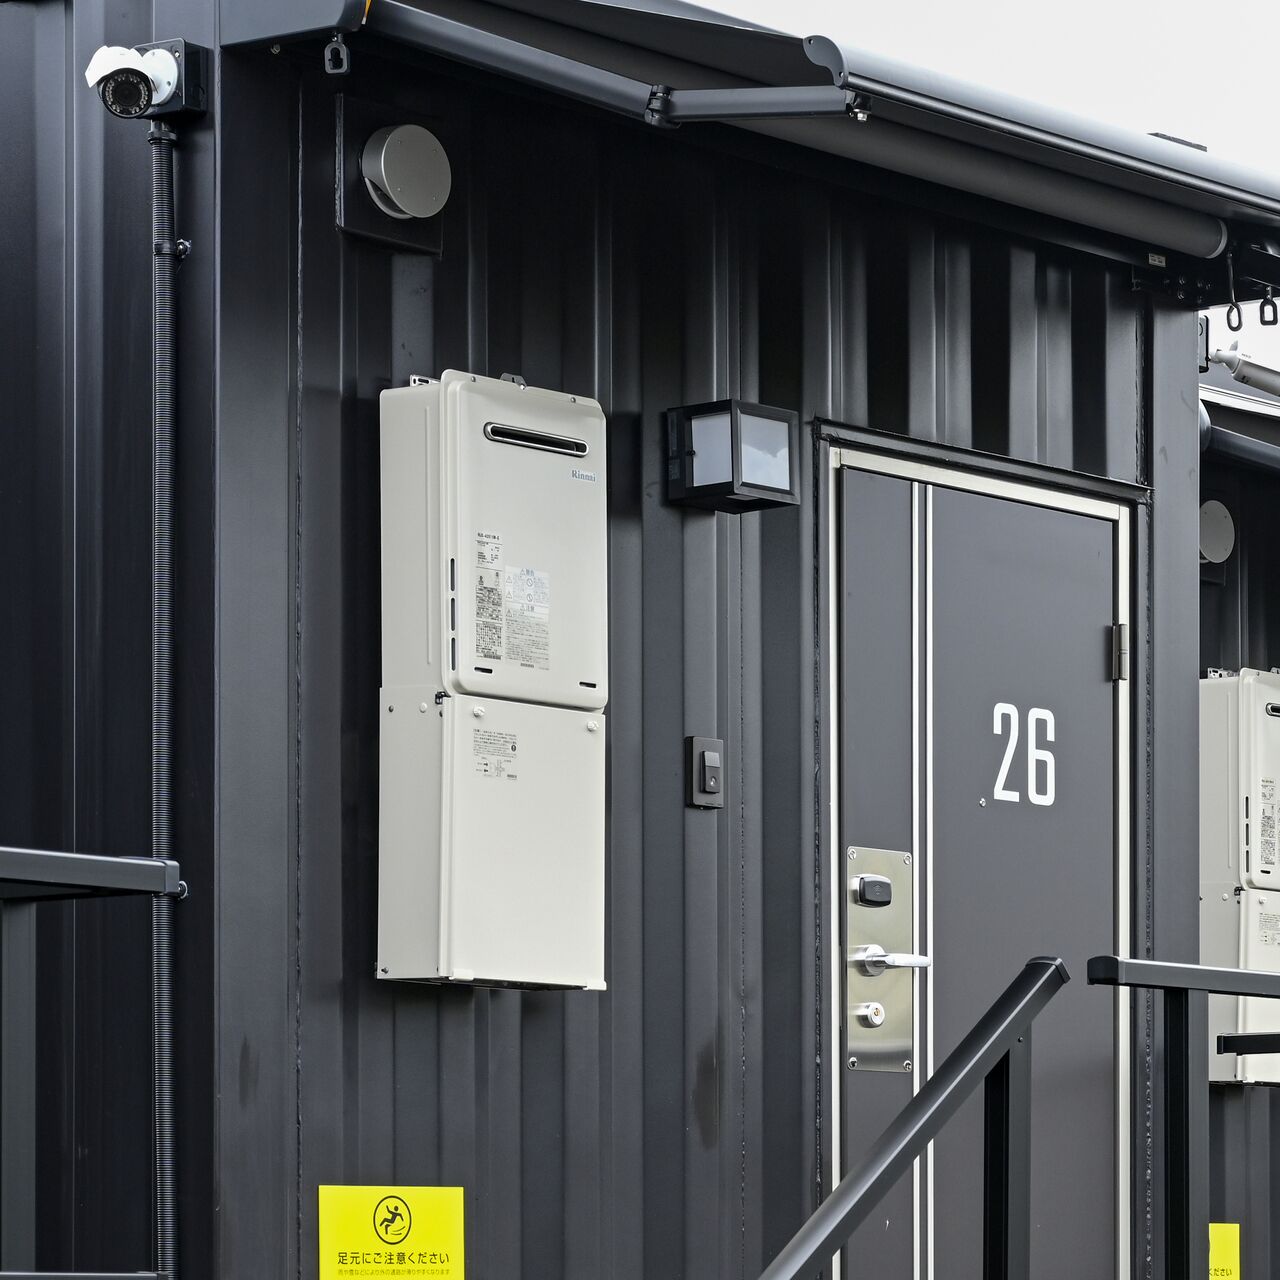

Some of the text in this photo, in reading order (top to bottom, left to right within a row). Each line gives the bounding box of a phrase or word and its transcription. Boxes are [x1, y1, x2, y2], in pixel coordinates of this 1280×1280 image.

[993, 702, 1056, 807] 26
[337, 1251, 450, 1265] 足元にご注意ください
